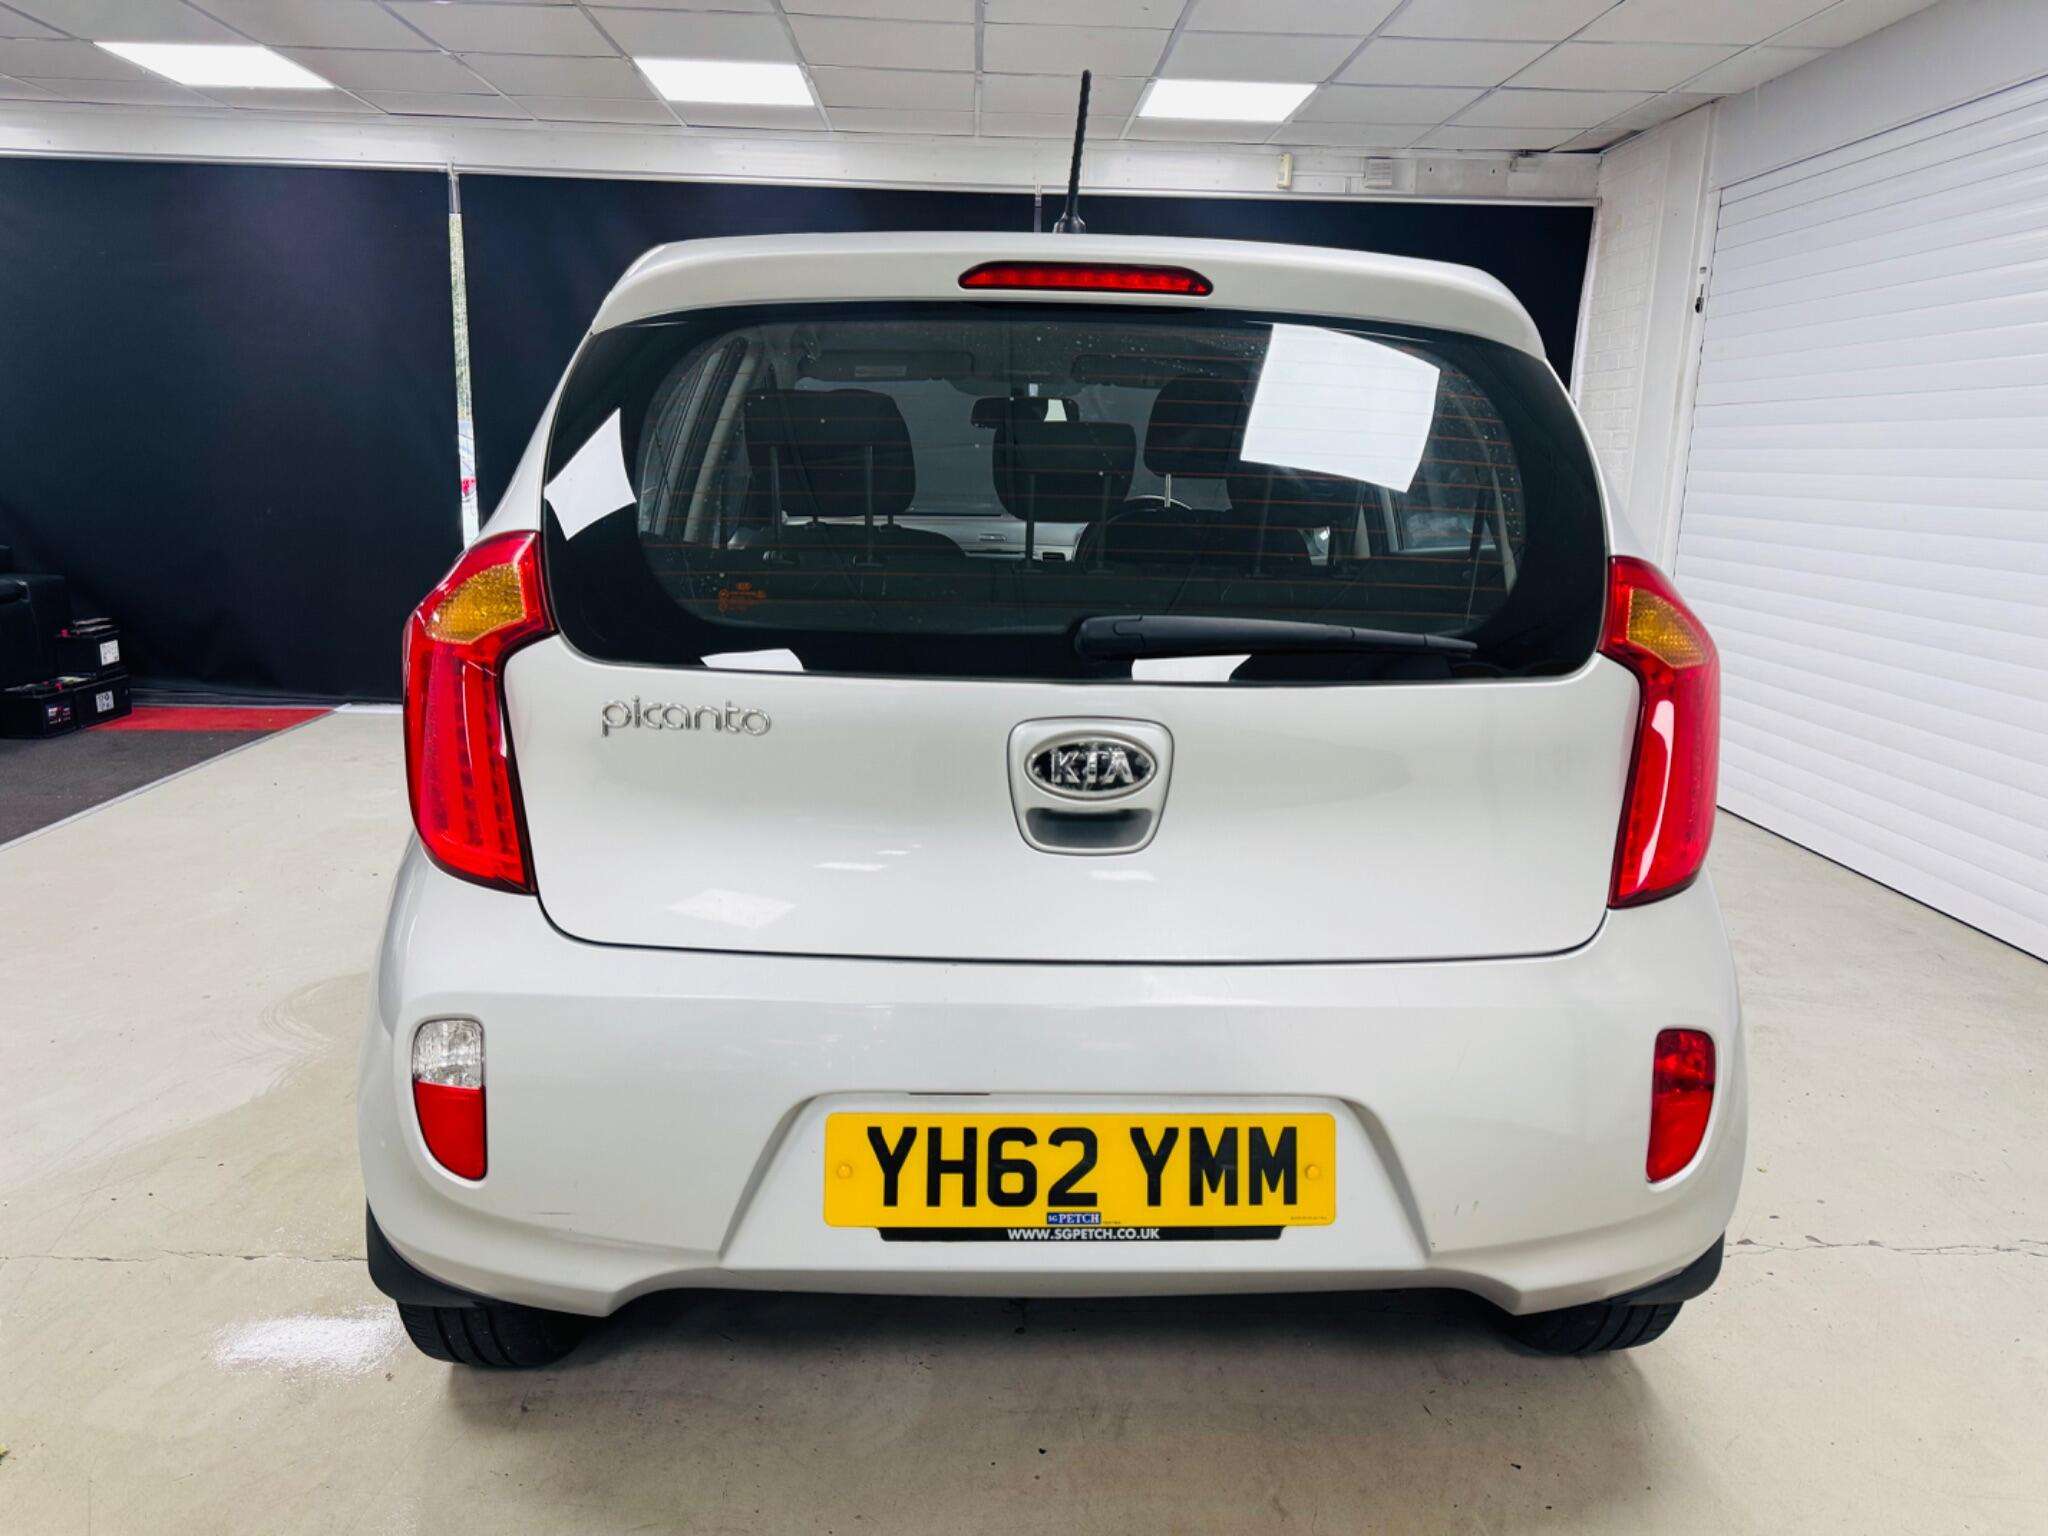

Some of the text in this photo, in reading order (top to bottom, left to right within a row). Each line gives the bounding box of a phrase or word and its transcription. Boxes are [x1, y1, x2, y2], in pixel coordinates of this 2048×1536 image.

[601, 695, 771, 737] picanto
[1050, 748, 1135, 784] KIA
[867, 1126, 1298, 1207] YH62 YMM
[1007, 1228, 1160, 1240] WWW.SGPETCH.CO.UK
[1059, 1213, 1100, 1224] PETCH
